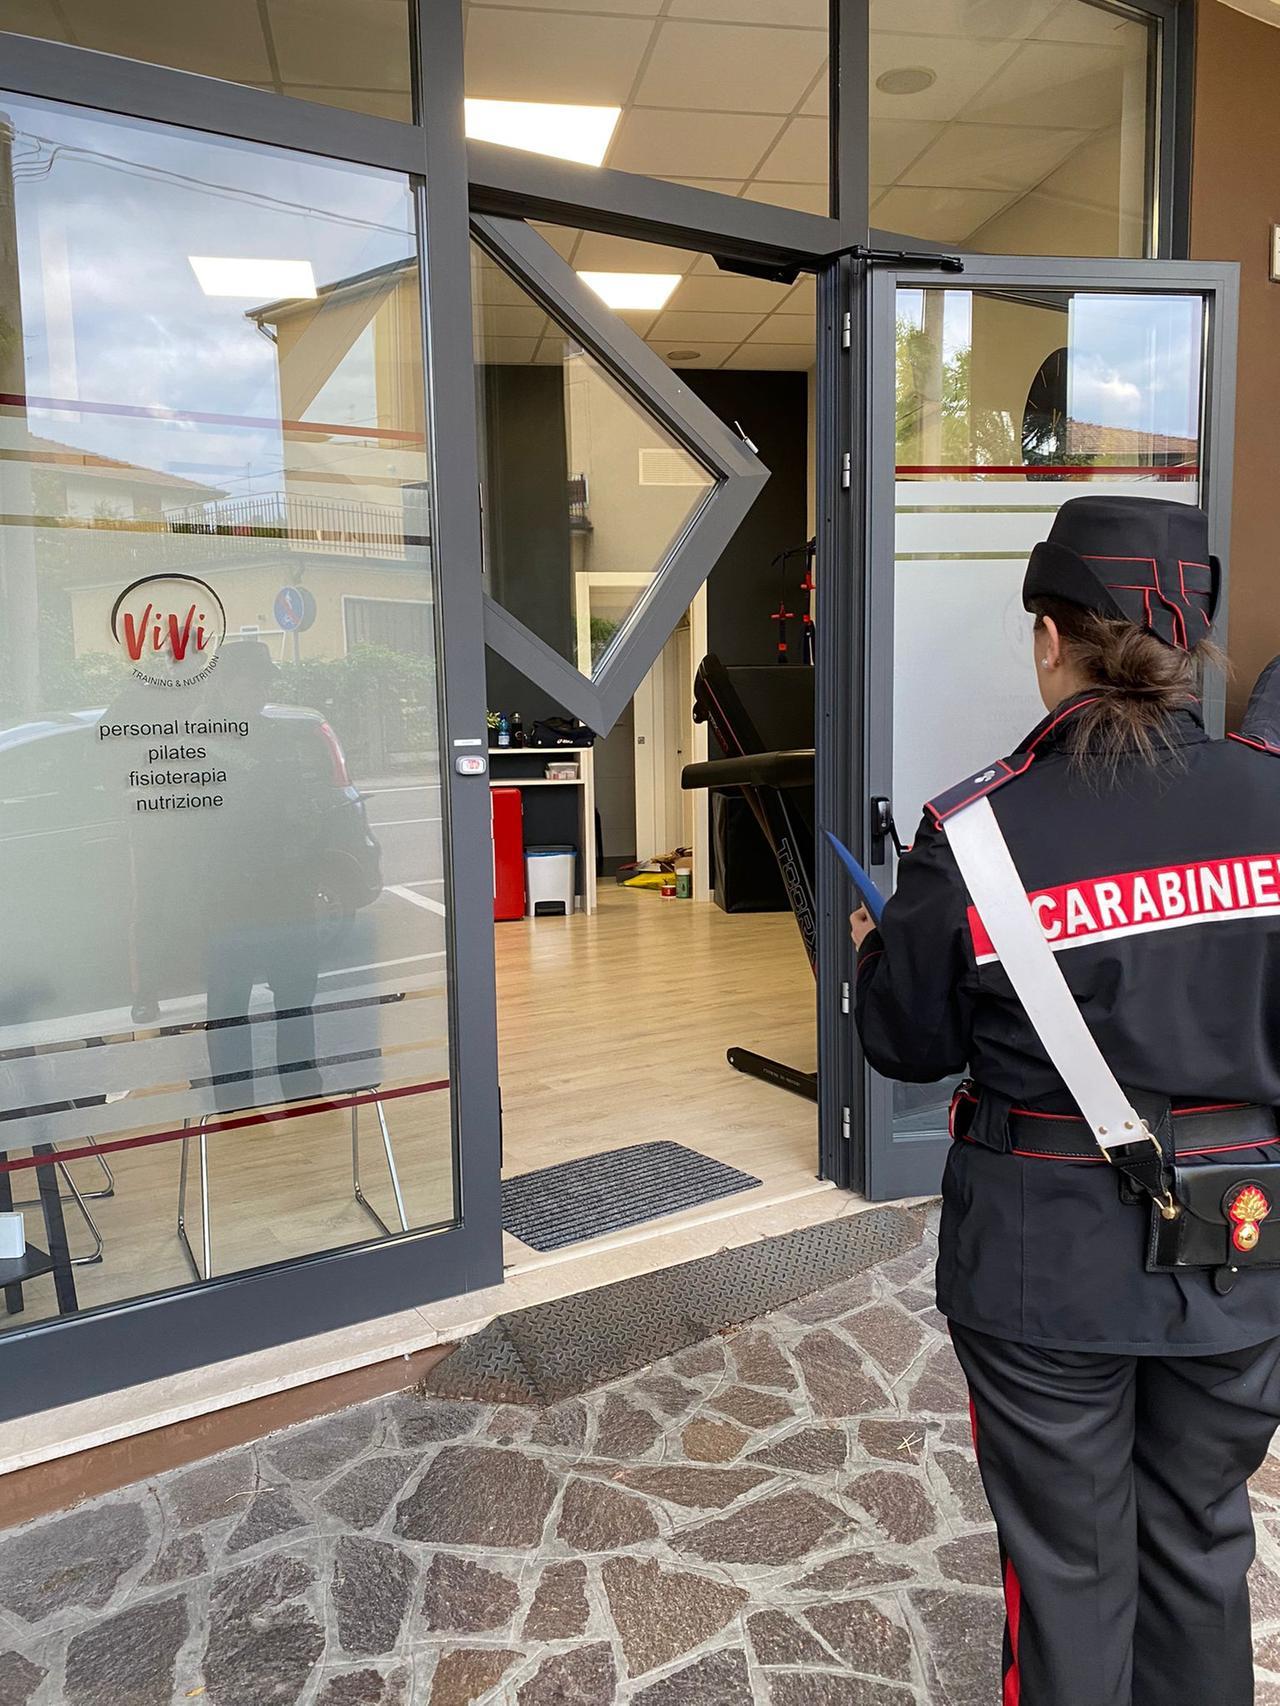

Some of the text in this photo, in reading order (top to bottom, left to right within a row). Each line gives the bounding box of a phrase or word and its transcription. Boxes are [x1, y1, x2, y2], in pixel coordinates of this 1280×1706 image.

[124, 603, 214, 661] ViVi
[132, 654, 220, 688] TRAINING & NUTRITION
[100, 719, 249, 740] personal training
[149, 745, 207, 763] pilates
[129, 768, 227, 787] fisioterapia
[137, 794, 224, 811] nutrizione
[1031, 859, 1280, 939] CARABINIE
